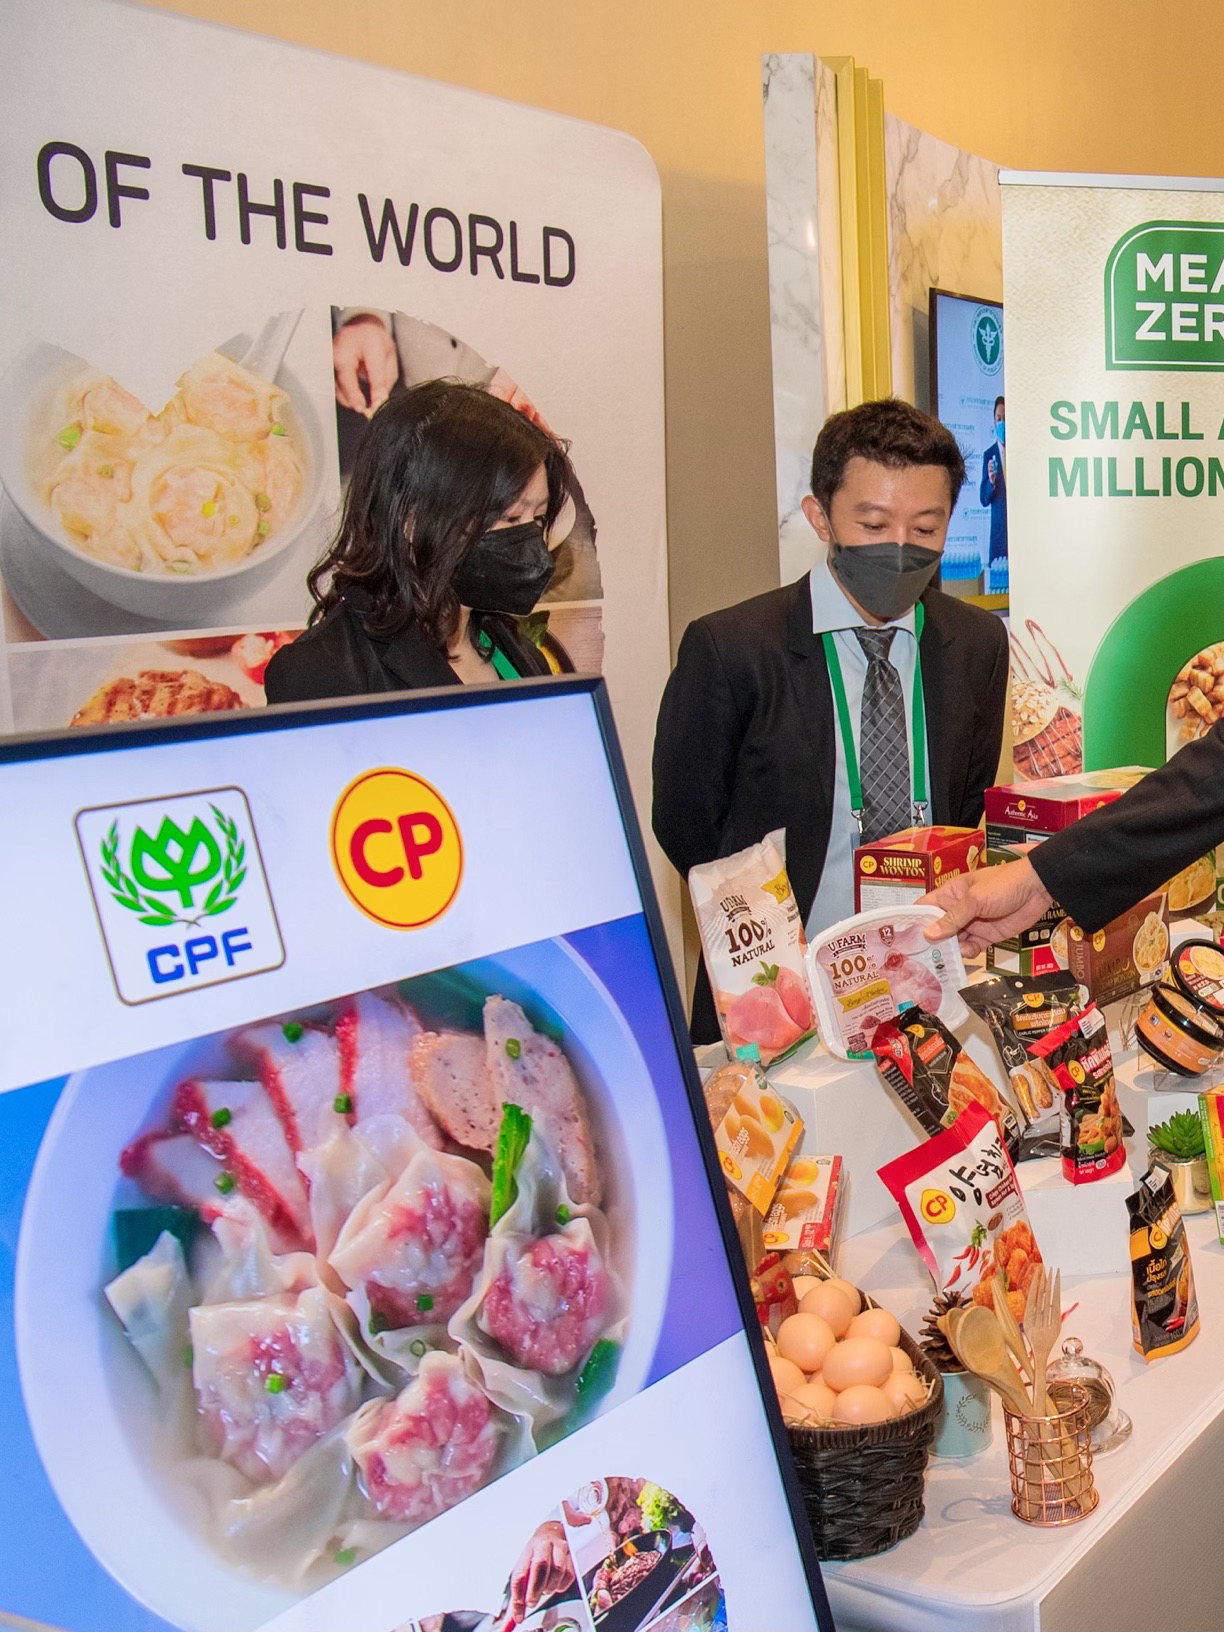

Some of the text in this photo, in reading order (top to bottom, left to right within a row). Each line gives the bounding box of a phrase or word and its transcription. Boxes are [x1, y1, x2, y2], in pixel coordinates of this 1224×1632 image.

[36, 140, 577, 288] OF THE WORLD
[1049, 400, 1204, 441] SMALL
[349, 811, 443, 888] CP
[883, 856, 923, 869] SHRIMP
[880, 866, 926, 877] WONTON
[724, 917, 772, 954] 100%
[146, 927, 252, 984] CPF
[731, 939, 775, 967] NATURAL
[830, 955, 877, 980] 100%
[1077, 943, 1086, 980] JUMBO
[834, 971, 880, 989] NATURAL
[925, 1194, 948, 1218] CP
